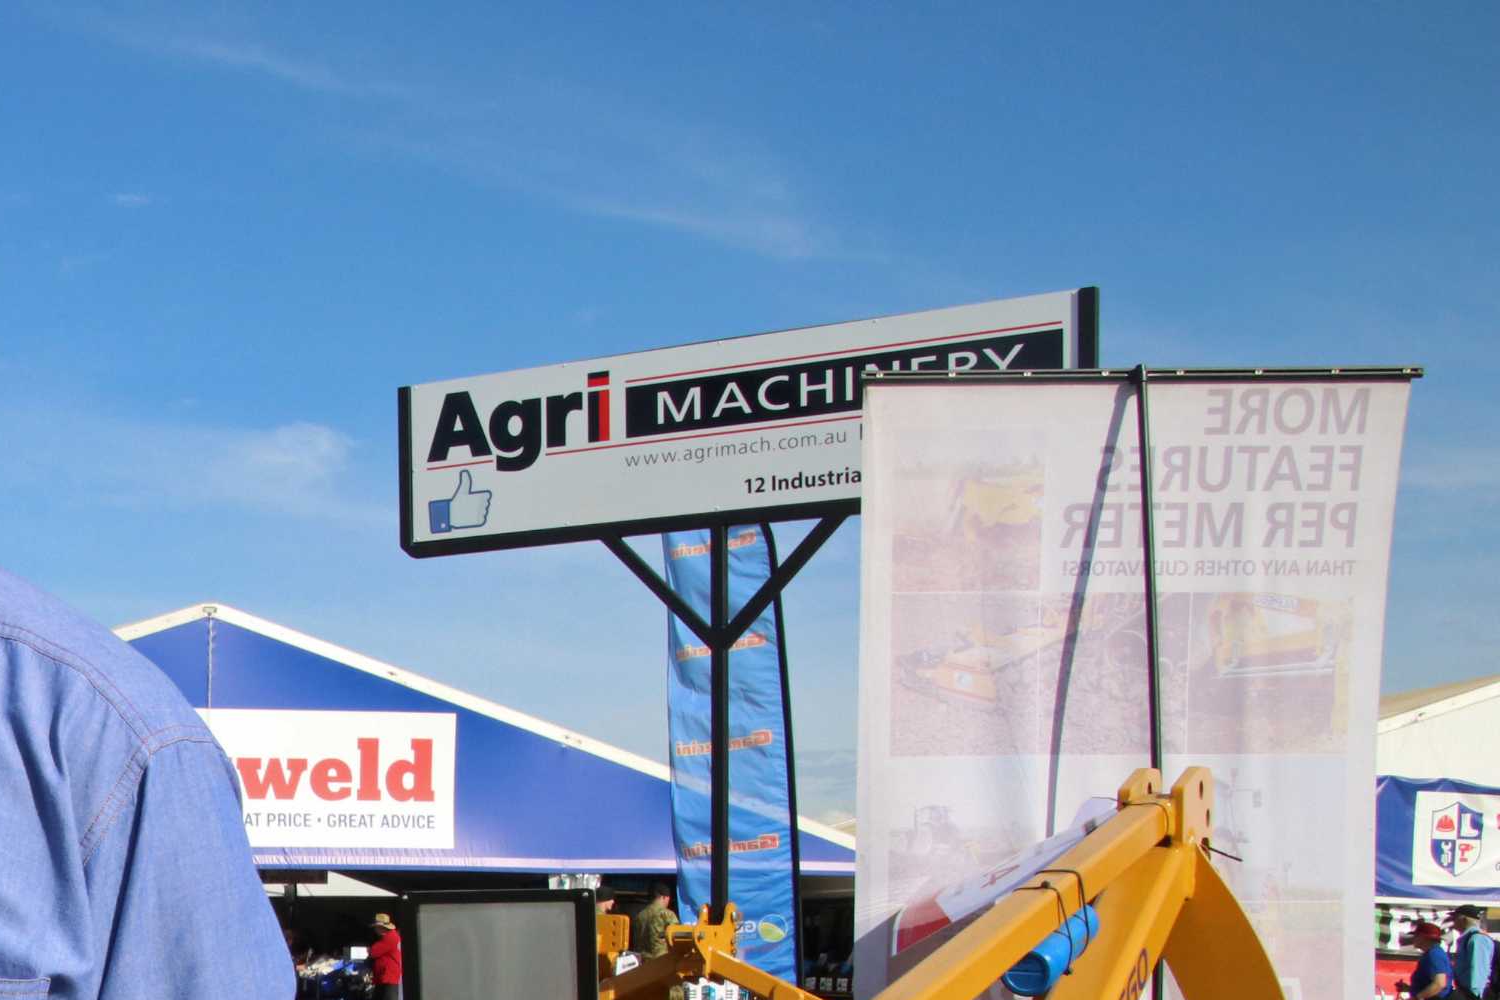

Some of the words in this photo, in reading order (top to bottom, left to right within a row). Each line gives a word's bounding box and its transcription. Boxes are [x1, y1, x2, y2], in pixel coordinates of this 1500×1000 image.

[426, 370, 611, 472] Agri
[624, 429, 848, 467] www.agrimach.com.au
[744, 477, 766, 494] 12
[231, 737, 436, 802] weld
[266, 813, 313, 828] PRICE
[327, 814, 376, 829] GREAT
[380, 814, 436, 829] ADVICE
